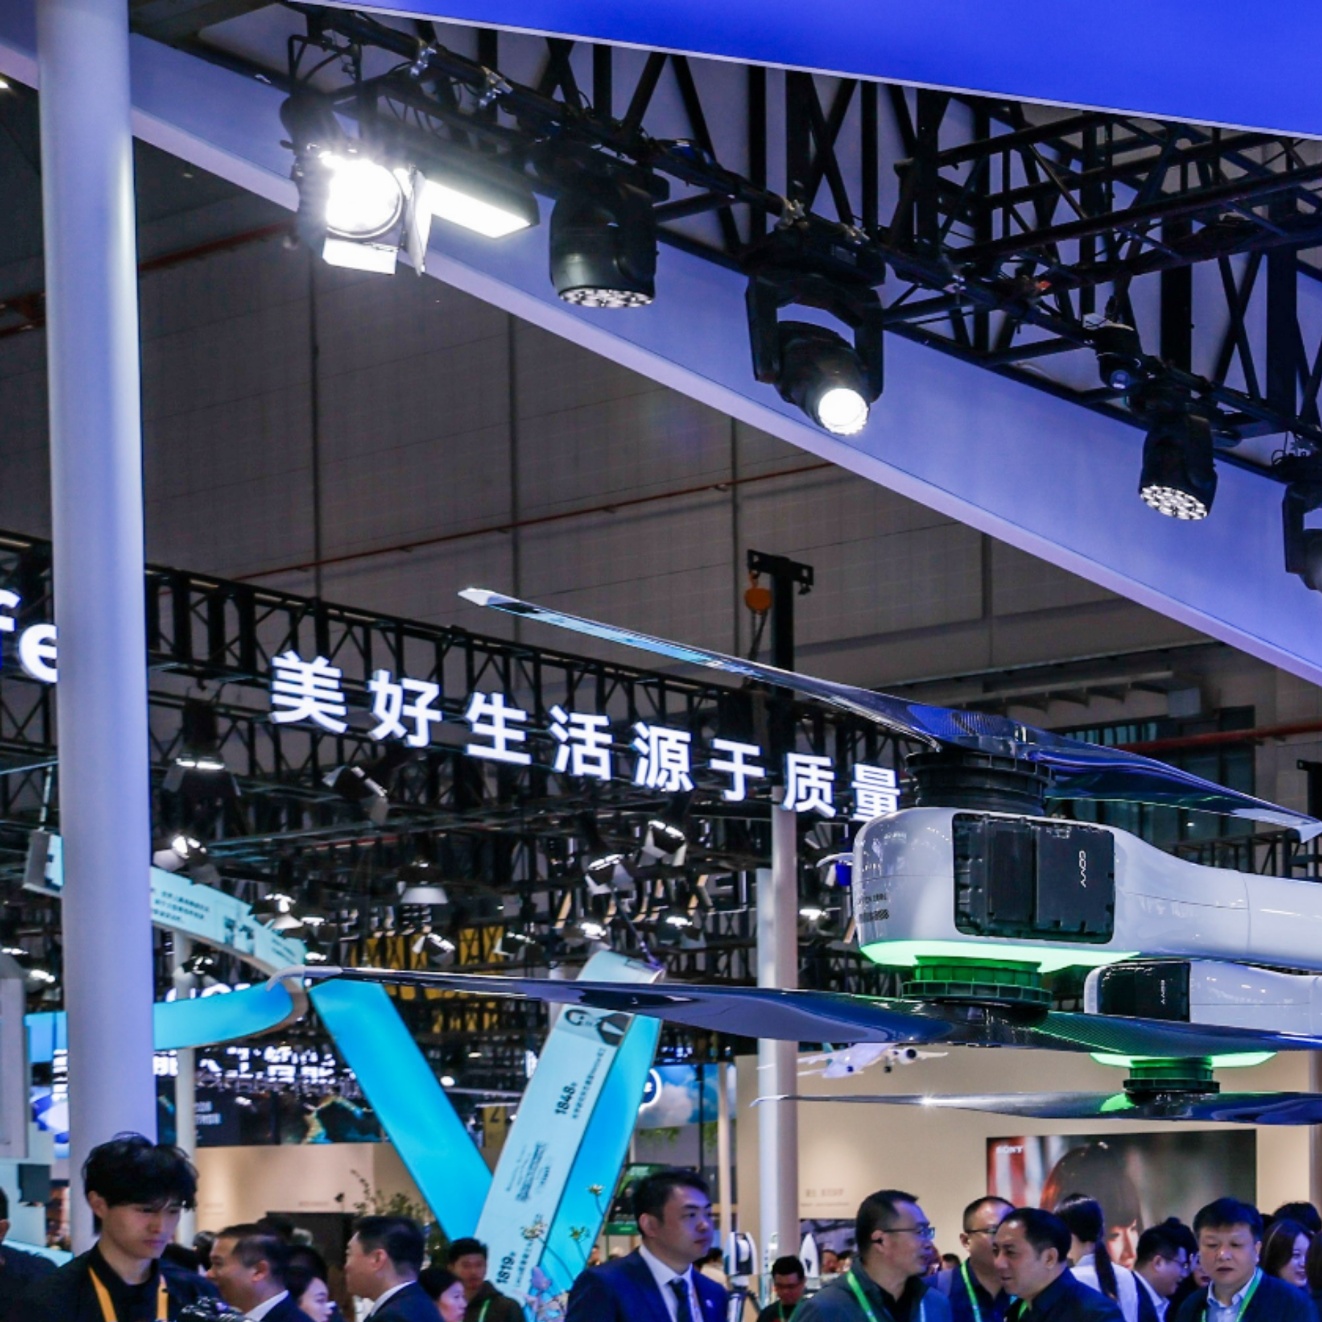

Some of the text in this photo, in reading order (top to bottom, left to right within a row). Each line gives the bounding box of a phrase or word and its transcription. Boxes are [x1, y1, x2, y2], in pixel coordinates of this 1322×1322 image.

[271, 650, 903, 822] 美好生活源于质量
